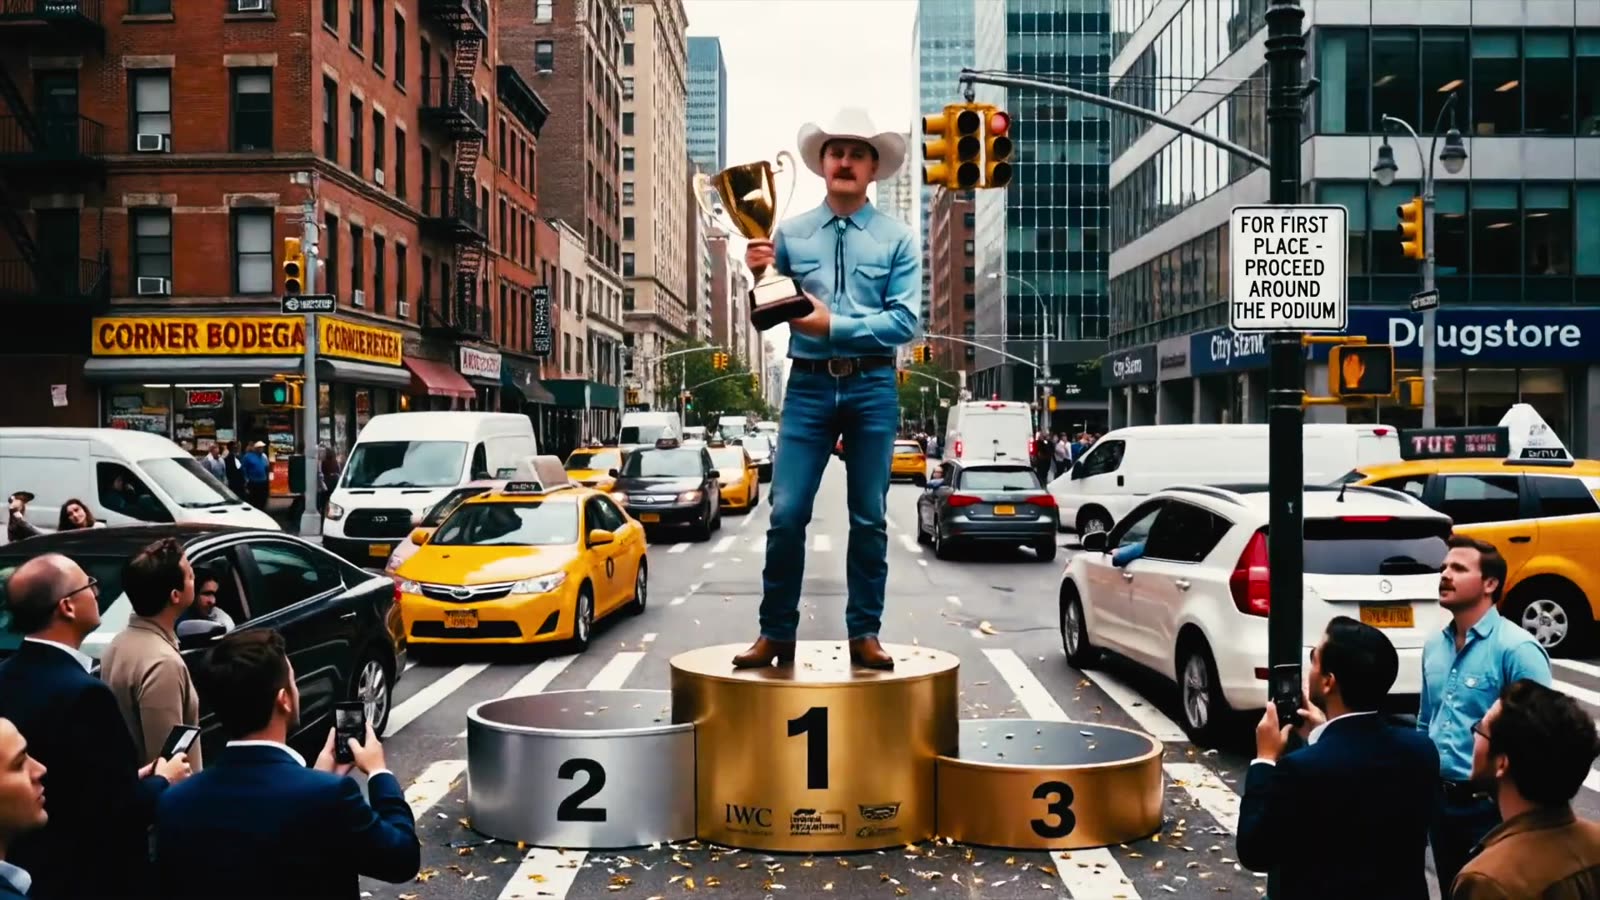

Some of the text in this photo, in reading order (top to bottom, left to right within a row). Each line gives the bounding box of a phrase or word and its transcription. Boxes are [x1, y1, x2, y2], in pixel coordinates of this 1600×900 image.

[1241, 216, 1328, 233] FOR FIRST
[1254, 238, 1309, 254] PLACE
[1245, 259, 1325, 276] PROCEED
[1249, 281, 1320, 297] AROUND
[1234, 302, 1336, 319] THE PODIUM
[100, 322, 305, 349] CORNER BODEGA
[787, 706, 831, 790] 1
[556, 758, 608, 823] 2
[726, 804, 772, 828] IWC
[1030, 781, 1077, 838] 3
